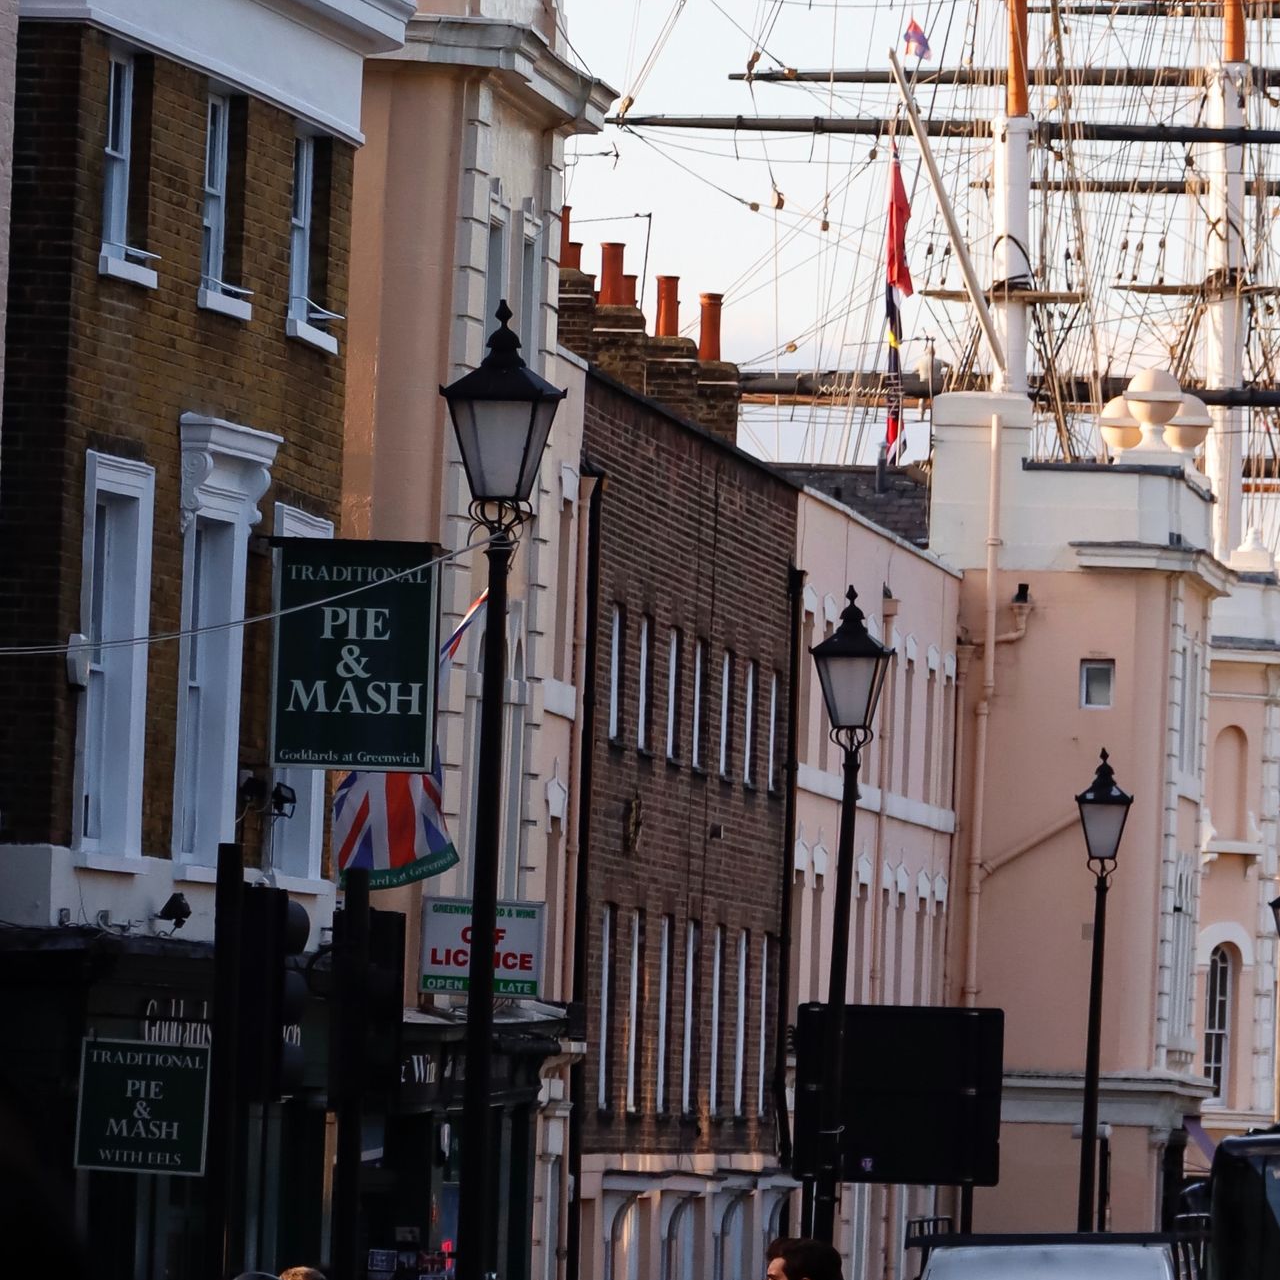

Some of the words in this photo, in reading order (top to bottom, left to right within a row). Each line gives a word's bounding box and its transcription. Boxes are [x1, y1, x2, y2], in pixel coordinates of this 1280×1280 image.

[287, 564, 428, 584] TRADITIONAL
[320, 606, 391, 641] PIE
[336, 644, 372, 679] &
[284, 679, 423, 715] MASH
[279, 749, 339, 762] Goddards
[341, 751, 353, 762] at
[357, 751, 421, 764] Greenwich
[516, 909, 536, 919] WINE
[431, 948, 533, 971] LICCE
[427, 978, 463, 990] OPEN
[500, 982, 531, 994] LATE
[90, 1049, 204, 1070] TRADITIONAL
[125, 1079, 165, 1100] PIE
[133, 1099, 153, 1120] &
[105, 1118, 180, 1140] MASH
[99, 1148, 143, 1164] WITH
[147, 1151, 182, 1166] EELS
